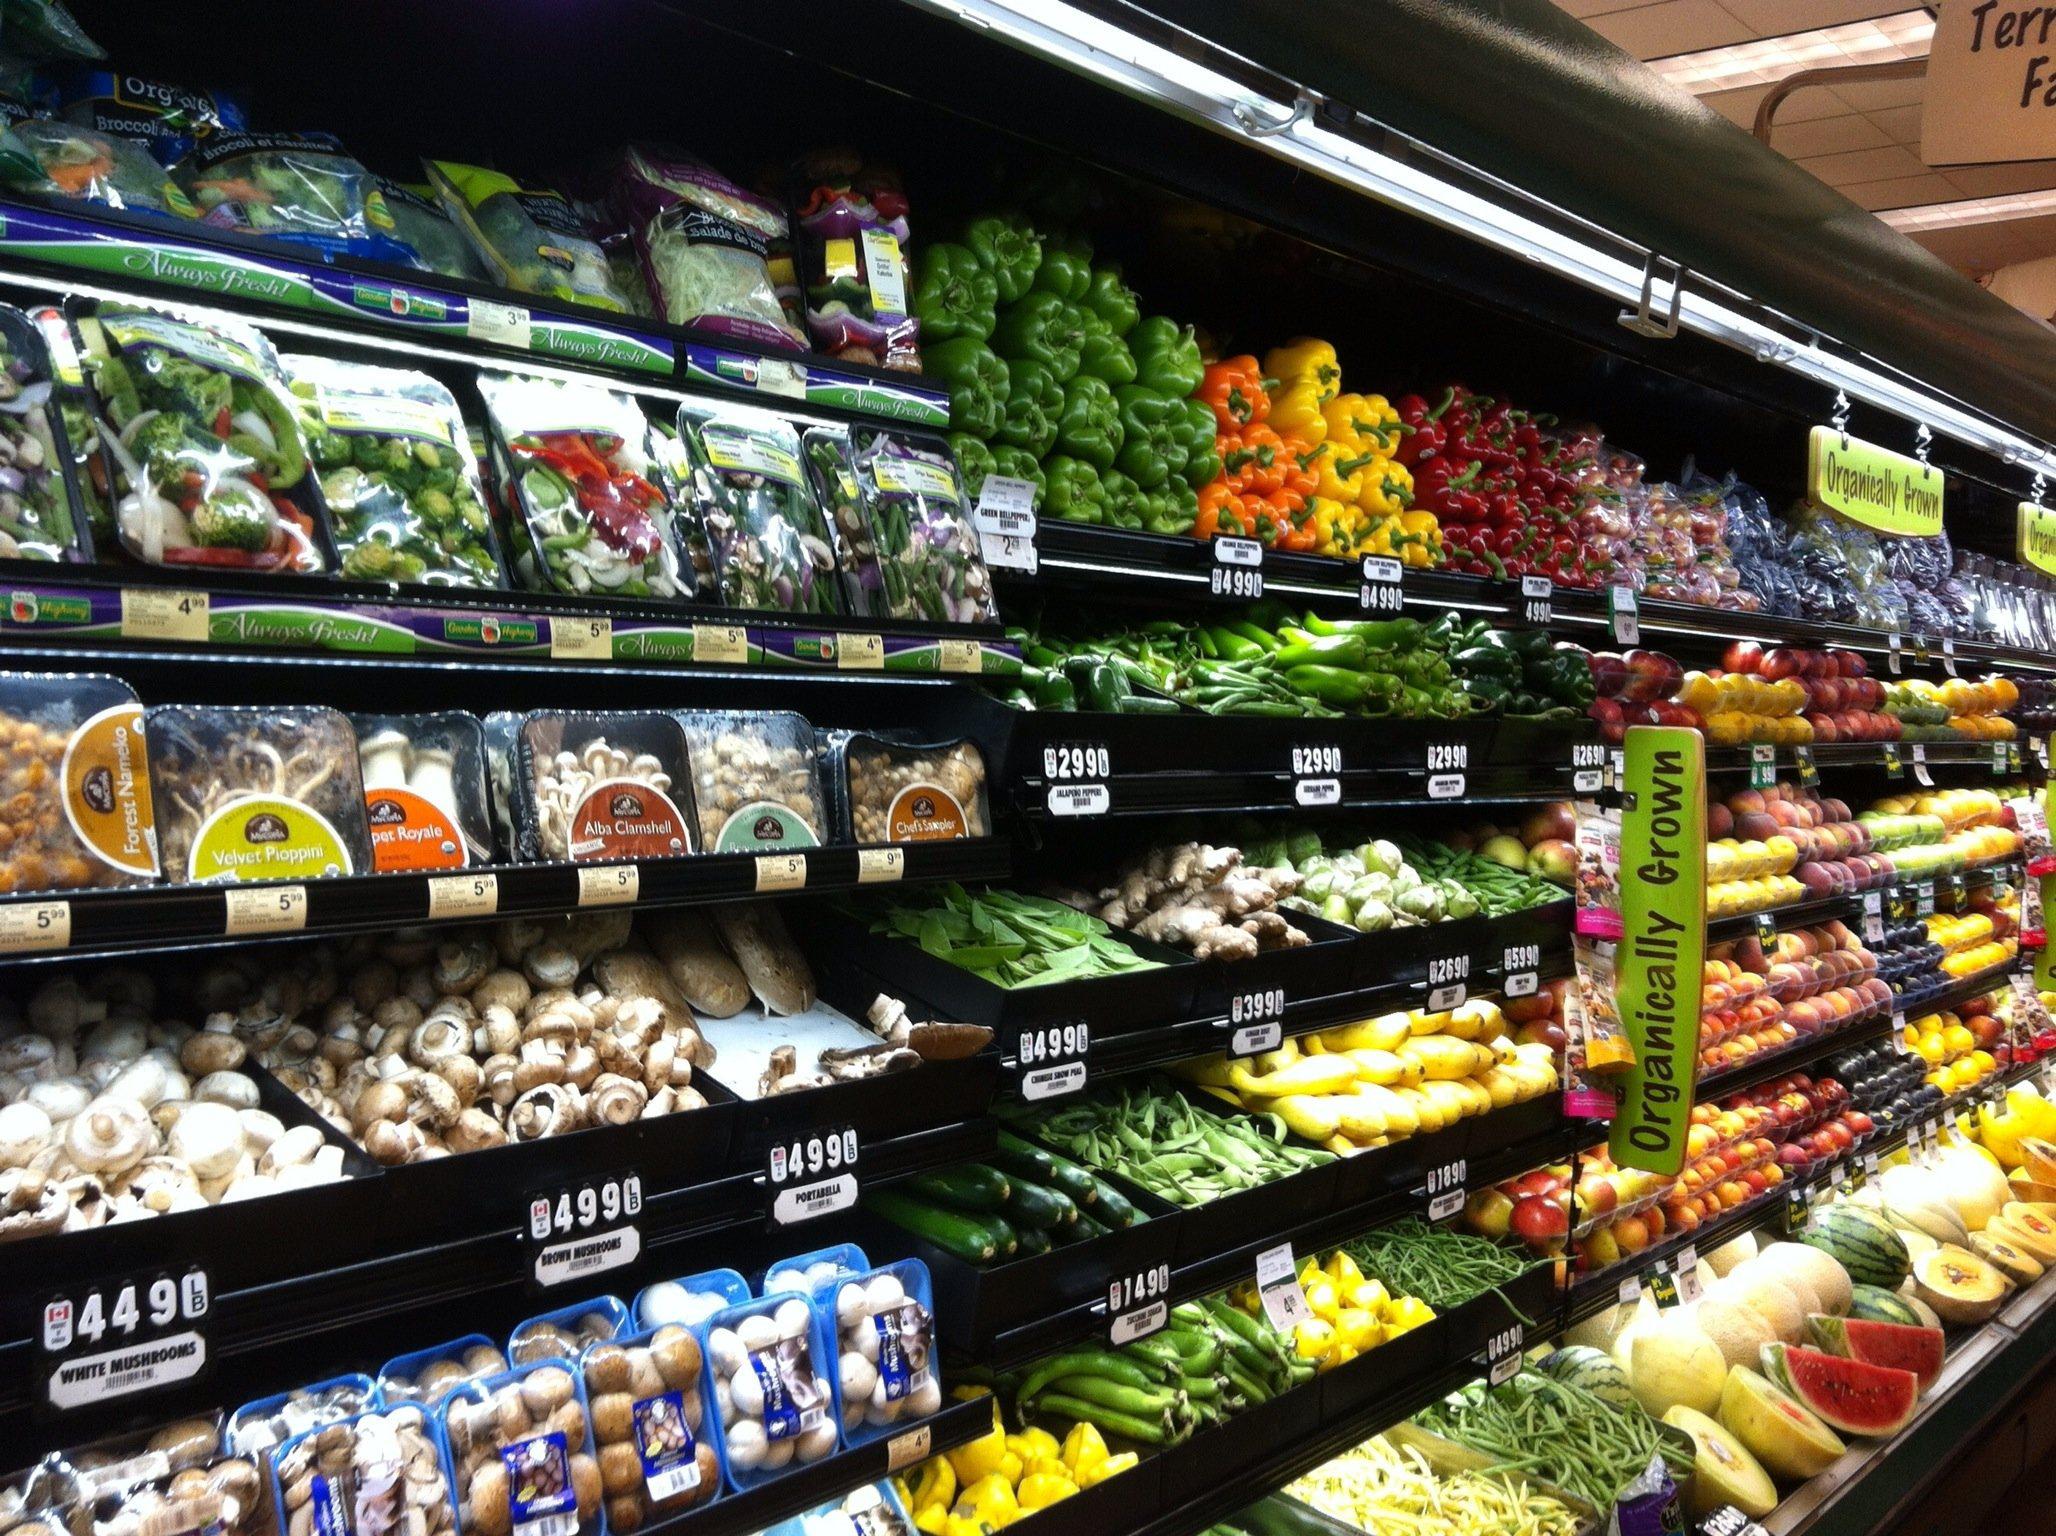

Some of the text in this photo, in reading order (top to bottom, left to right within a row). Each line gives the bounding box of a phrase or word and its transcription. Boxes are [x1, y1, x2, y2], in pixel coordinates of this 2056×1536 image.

[123, 250, 292, 298] Always Fresh!
[530, 328, 650, 366] Always Fresh!
[842, 388, 930, 420] Always Fresh!
[1827, 451, 1939, 520] Organically Grown
[980, 507, 999, 518] GREEN
[1223, 569, 1253, 597] 499
[1370, 585, 1395, 610] 499
[209, 614, 379, 646] Always Fresh!
[619, 634, 688, 661] Always
[1058, 748, 1097, 779] 299
[1303, 747, 1332, 773] 299
[1436, 745, 1459, 769] 299
[1580, 745, 1598, 766] 269
[113, 725, 141, 855] Forest Nameko
[398, 824, 443, 845] Royale
[584, 817, 673, 836] Alba Clamshell
[896, 819, 957, 835] Chef's Sampler
[212, 844, 324, 867] Velvet Pioppini
[1512, 945, 1532, 969] 599
[1629, 750, 1686, 1155] Organically Grown
[1243, 991, 1275, 1020] 399
[1034, 1026, 1076, 1061] 499
[788, 1134, 842, 1179] 499
[1437, 1162, 1459, 1191] 189
[554, 1182, 620, 1234] 499
[795, 1183, 841, 1204] PORTABELLA
[541, 1236, 622, 1267] BROWN MUSHROOMS
[1124, 1268, 1158, 1307] 149
[77, 1278, 177, 1344] 449
[60, 1341, 197, 1385] WHITE MUSHROOMS
